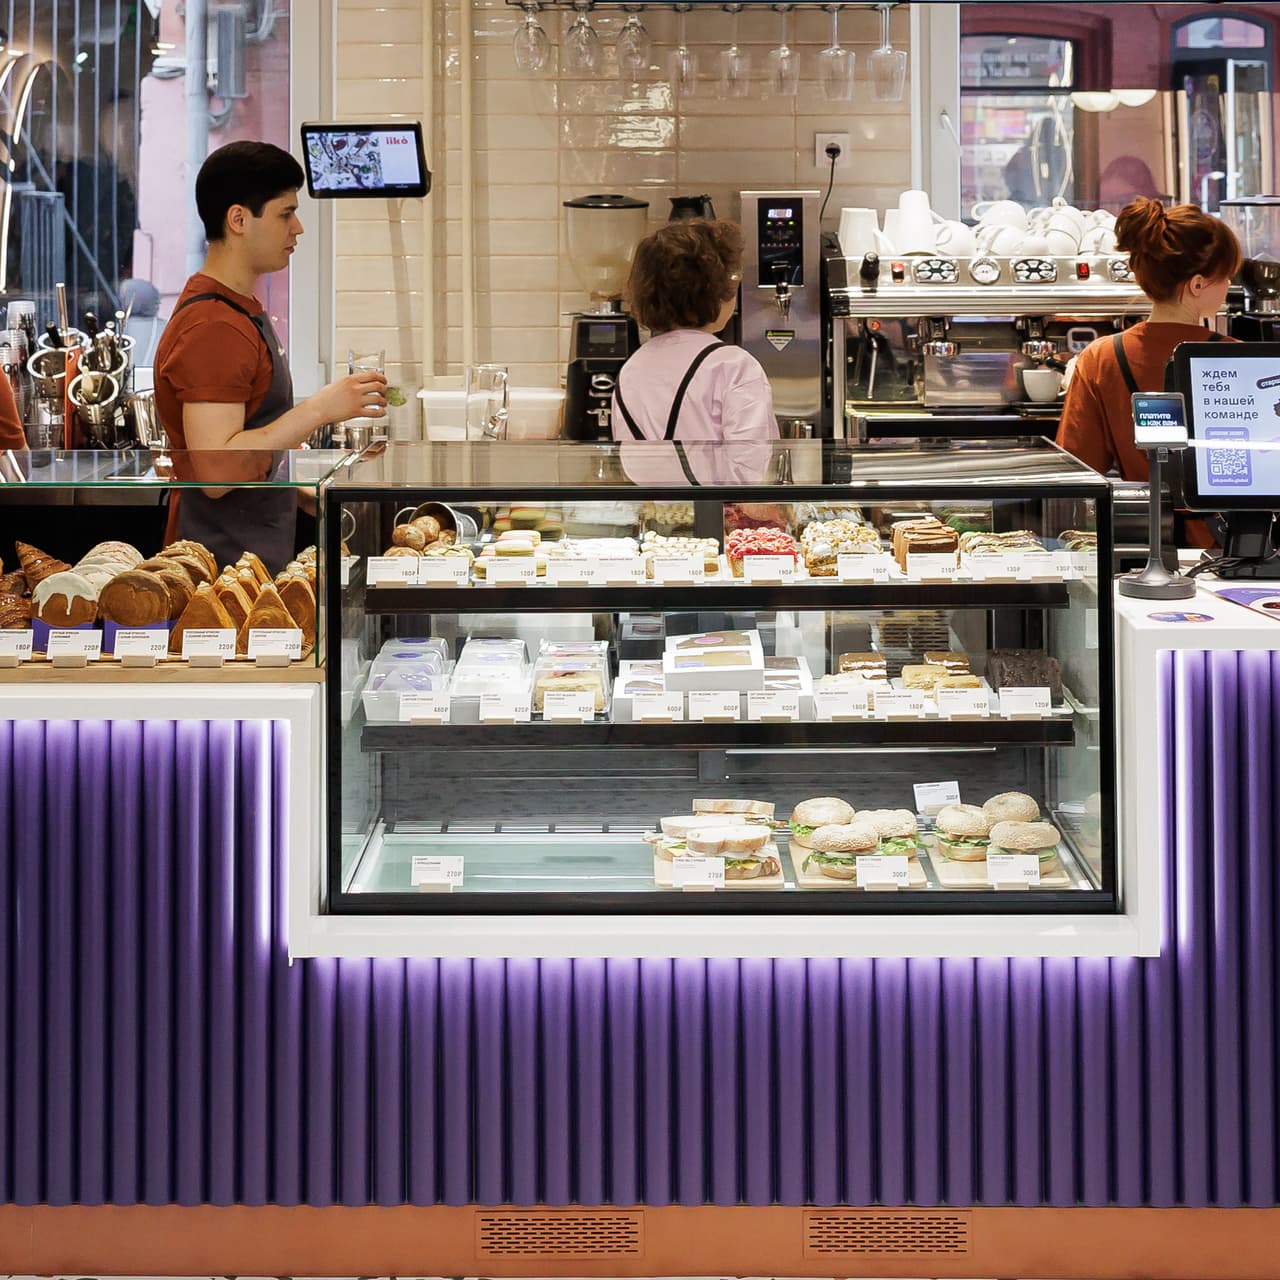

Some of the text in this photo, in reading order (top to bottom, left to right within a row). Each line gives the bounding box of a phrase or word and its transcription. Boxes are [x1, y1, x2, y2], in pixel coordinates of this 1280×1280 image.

[1202, 370, 1237, 379] ждем
[1203, 382, 1230, 391] тебя
[1214, 395, 1255, 405] нашей
[1205, 412, 1259, 420] команде
